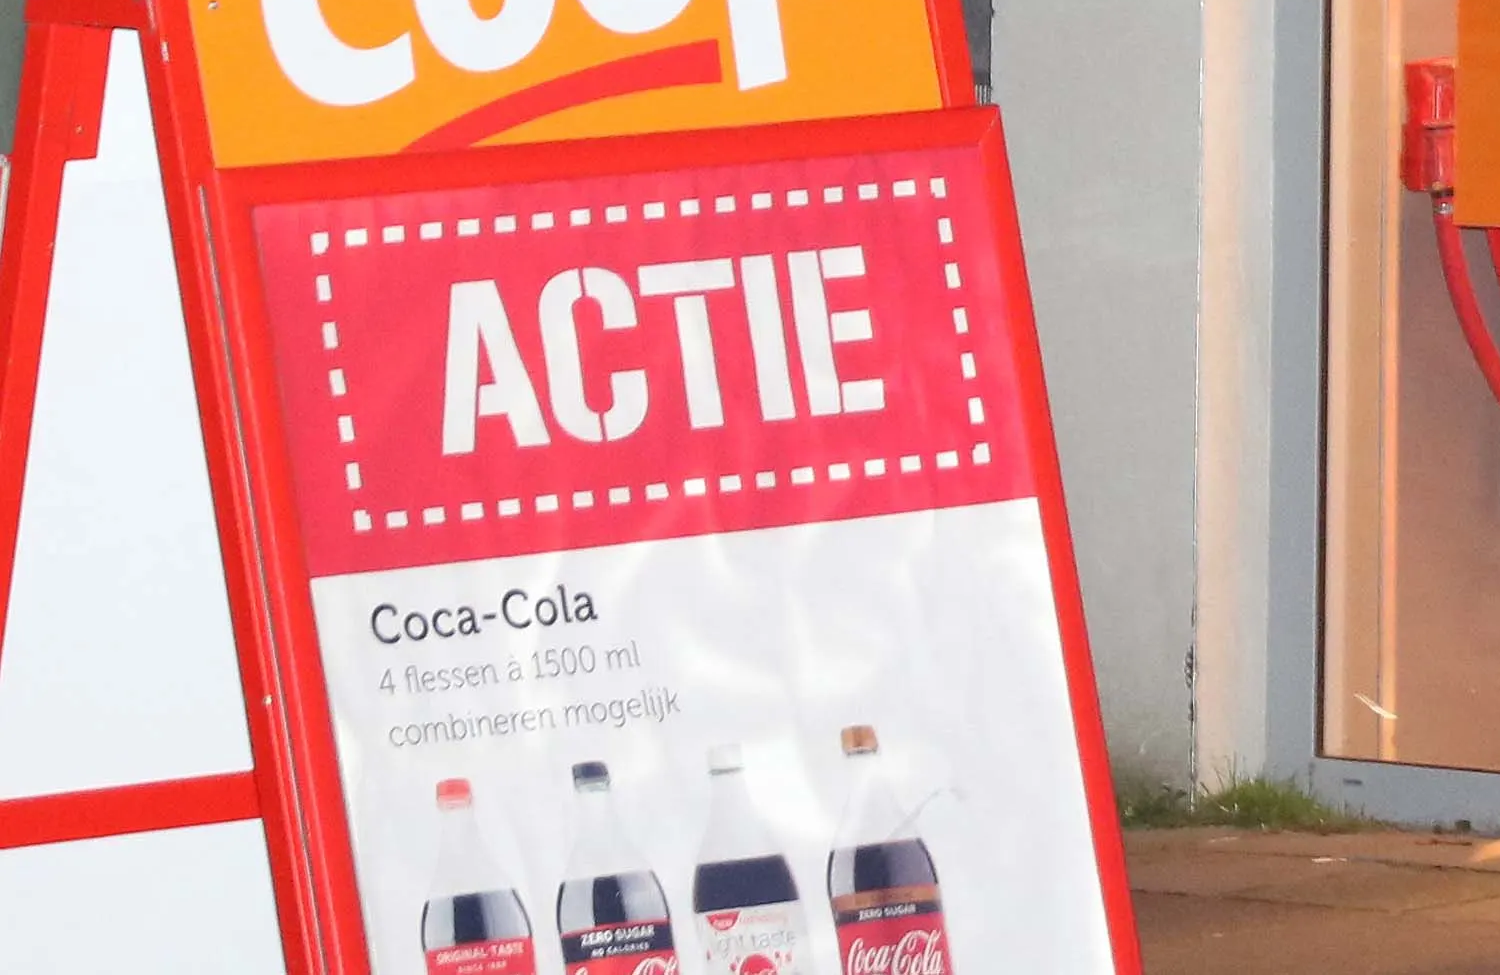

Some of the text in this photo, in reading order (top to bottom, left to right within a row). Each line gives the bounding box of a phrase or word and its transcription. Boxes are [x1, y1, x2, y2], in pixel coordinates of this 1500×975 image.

[442, 245, 886, 457] ACTIE
[371, 584, 599, 645] Coca-Cola
[378, 666, 396, 695] 4
[404, 663, 500, 695] flessen
[531, 644, 596, 679] 1500
[605, 639, 642, 670] ml
[388, 685, 682, 748] combineren mogelijk
[580, 924, 656, 947] ZERO SUGAR
